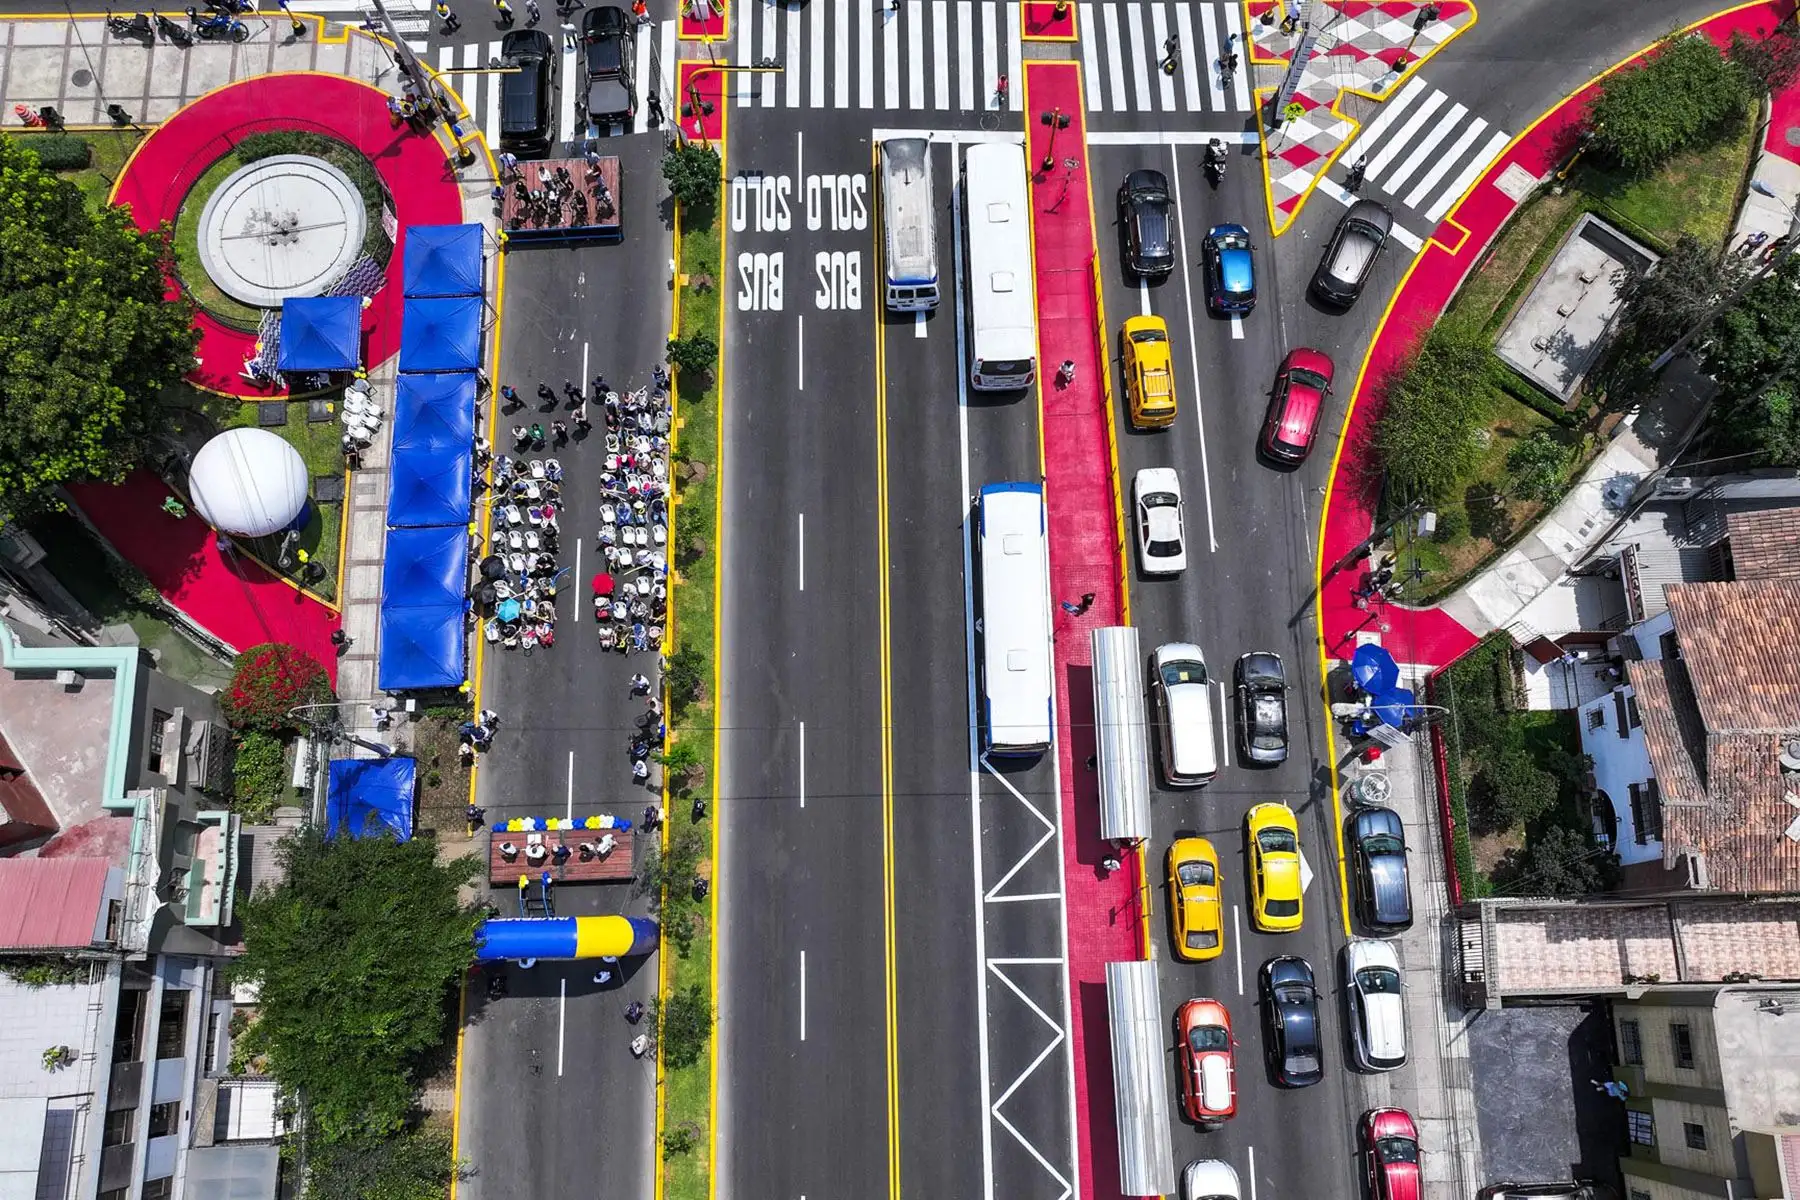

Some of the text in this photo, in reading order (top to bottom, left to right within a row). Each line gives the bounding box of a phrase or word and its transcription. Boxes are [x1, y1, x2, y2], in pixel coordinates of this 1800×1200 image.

[732, 175, 791, 232] SOLO
[806, 173, 868, 231] SOLO
[738, 251, 784, 311] BUS
[815, 250, 862, 310] BUS
[1627, 545, 1641, 600] BOTICA
